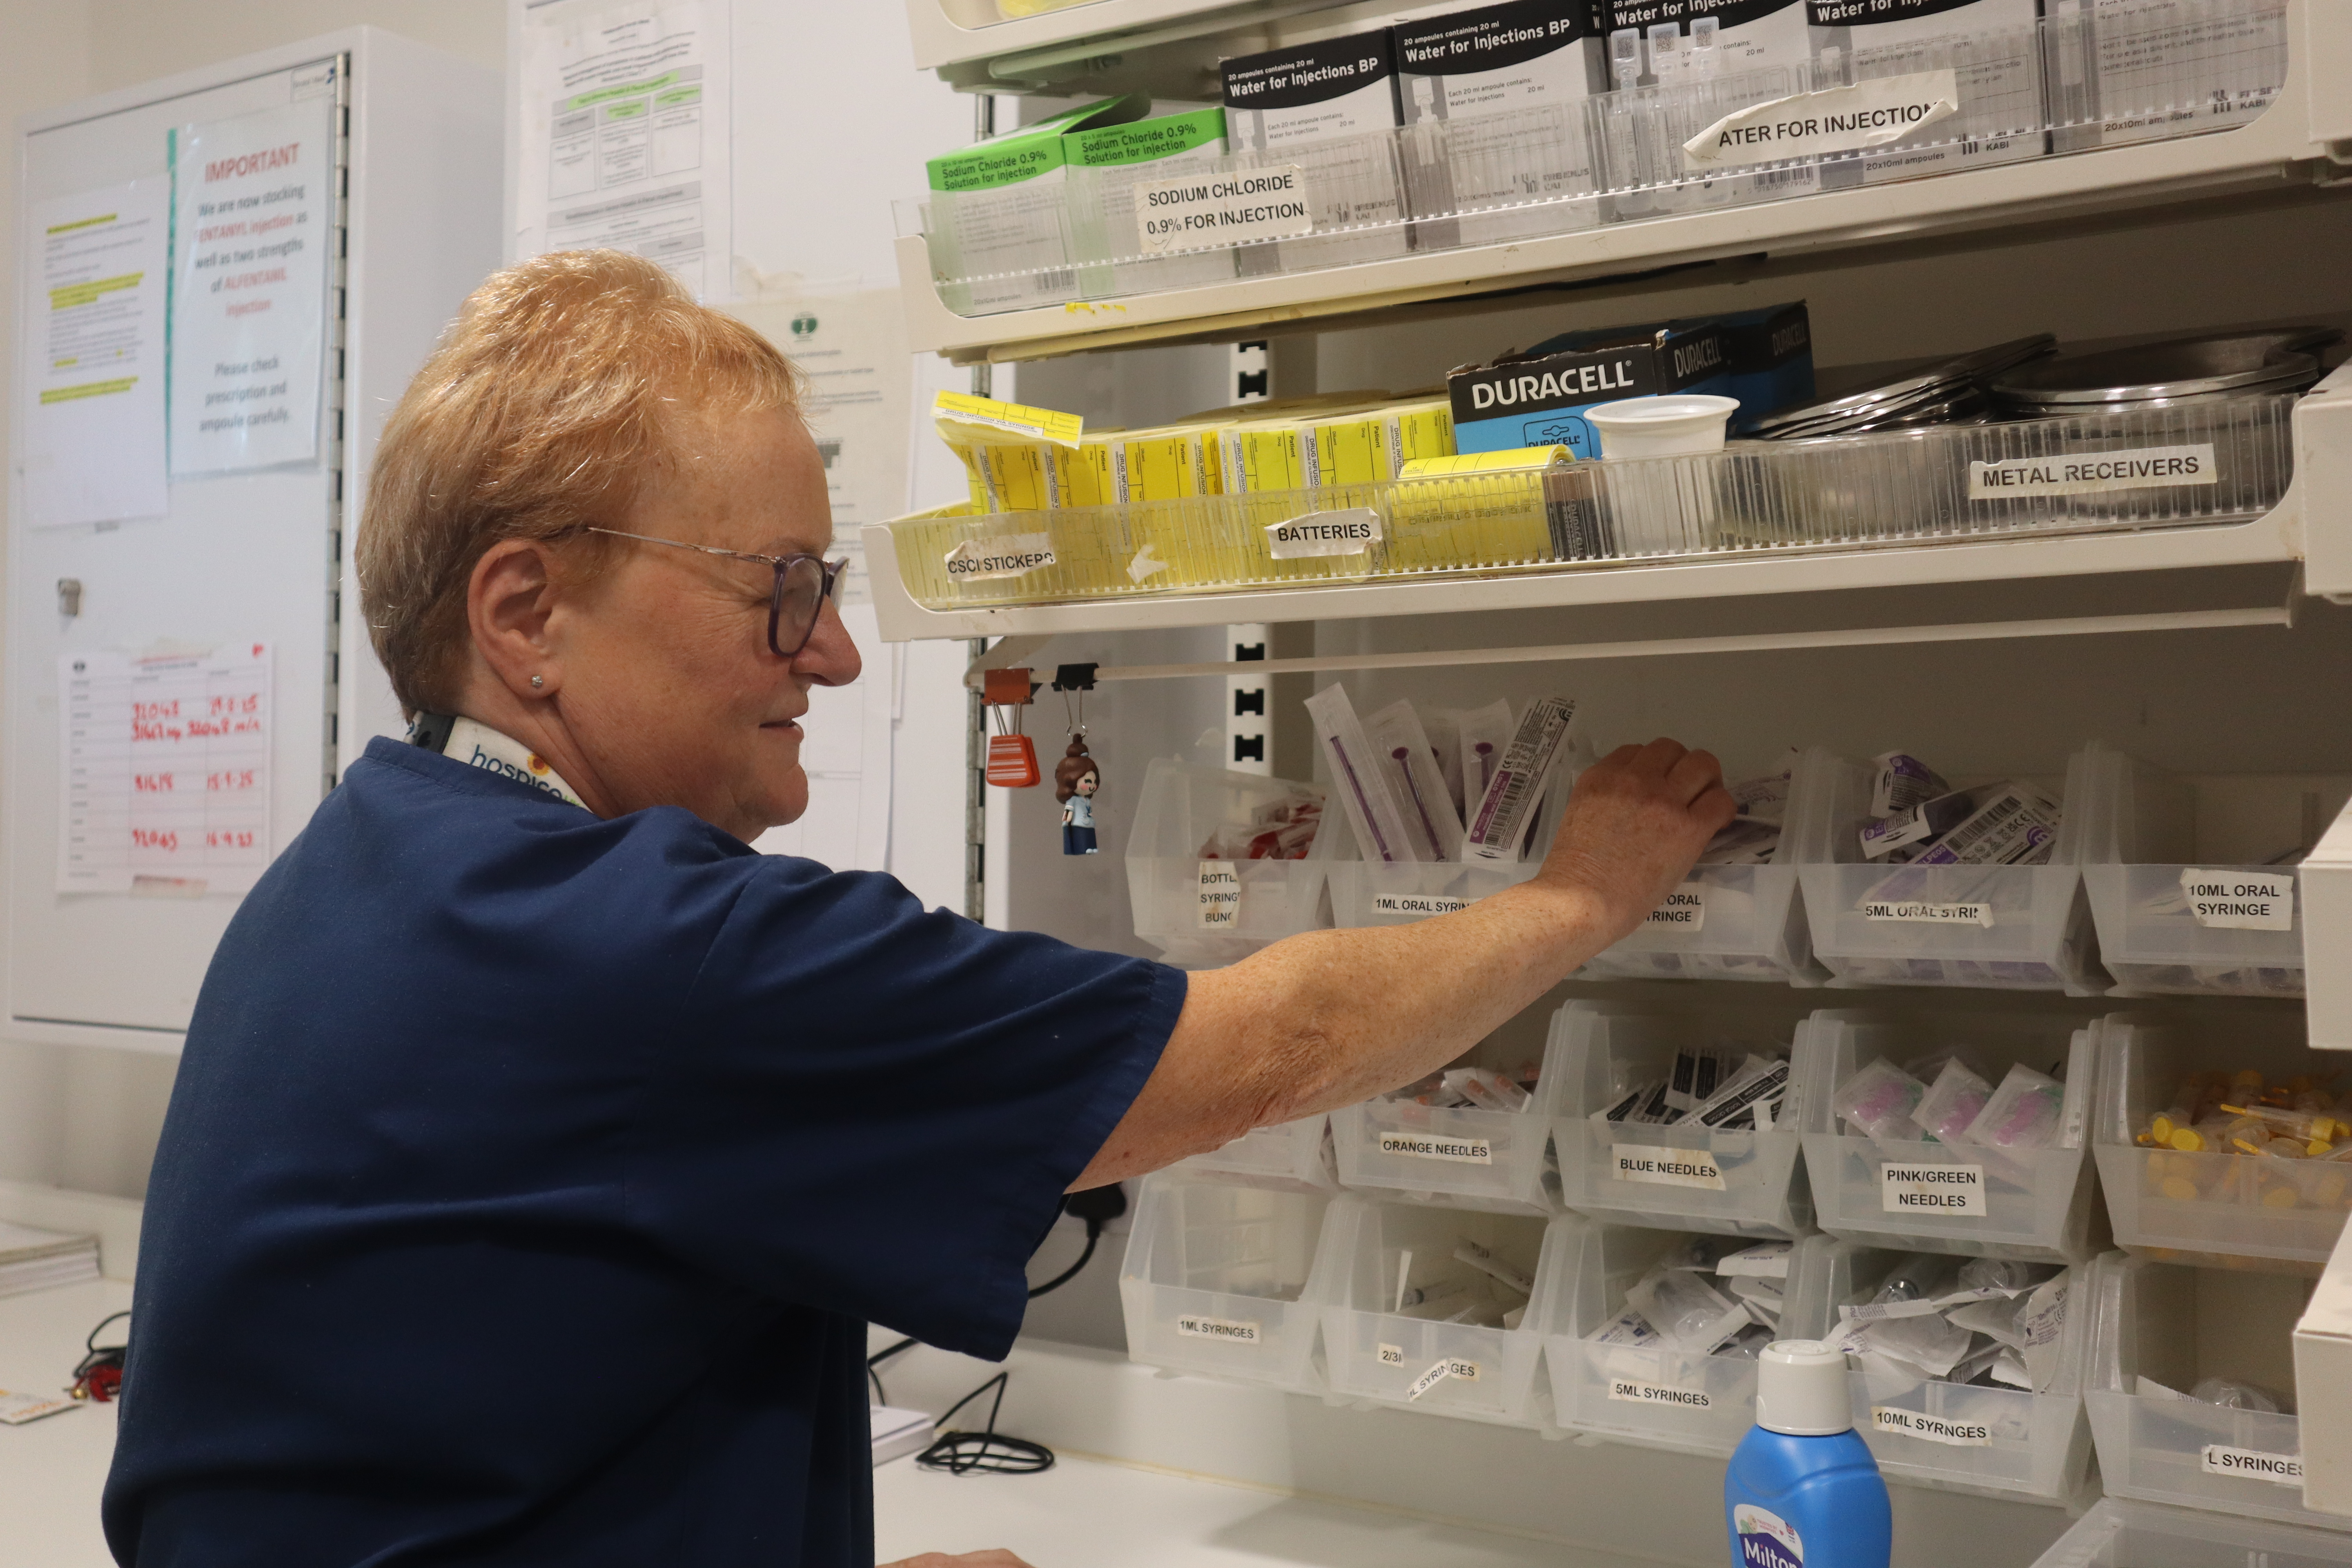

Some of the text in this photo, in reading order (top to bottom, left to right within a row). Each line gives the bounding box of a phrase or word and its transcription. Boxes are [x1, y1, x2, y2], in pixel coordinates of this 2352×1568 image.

[1615, 3, 1684, 26] Water for
[1817, 3, 1864, 22] Water
[1405, 19, 1570, 63] Water for Injections BP
[1414, 32, 1444, 45] ampoules
[1445, 25, 1478, 38] containing
[1479, 22, 1490, 31] 20
[1724, 40, 1751, 50] contains:
[1230, 57, 1378, 97] Water for Injections BP
[1238, 68, 1264, 80] ampoules
[1265, 62, 1295, 74] containing
[1481, 82, 1505, 94] ampoule
[1506, 77, 1532, 88] contains:
[1450, 98, 1467, 107] Water
[1477, 92, 1504, 102] Injections
[2239, 99, 2266, 109] KABI
[1297, 116, 1319, 127] ampoule
[1320, 112, 1344, 122] contains:
[2105, 119, 2146, 132] 20x10ml
[1082, 123, 1196, 152] Sodium Chloride 0.9%
[1294, 126, 1319, 136] Injections
[1719, 125, 1771, 147] ATER
[1777, 118, 1818, 139] FOR
[1084, 140, 1186, 165] Solution for injection
[1986, 141, 2009, 151] KABI
[205, 142, 300, 182] IMPORTANT
[942, 150, 1047, 179] Sodium Chloride 0.9%
[1866, 152, 1945, 171] 20x10ml ampoules
[944, 165, 1037, 190] Solution for injection
[198, 183, 305, 216] We are now stocking
[1149, 185, 1208, 207] SODIUM
[1212, 174, 1294, 198] CHLORIDE
[1147, 202, 1305, 235] 0.9% FOR INJECTION
[196, 252, 216, 269] well
[997, 293, 1022, 303] ampoules
[1771, 322, 1806, 356] DURACELL
[1674, 335, 1722, 379] DURACELL
[269, 378, 287, 396] and
[1472, 361, 1634, 409] DURACELL
[965, 413, 995, 423] INFUSION
[1007, 422, 1035, 430] SYRINGE
[1984, 456, 2200, 487] METAL RECEIVERS
[1278, 523, 1371, 541] BATTERIES
[947, 559, 980, 573] CSCI
[1201, 873, 1236, 884] BOTTL
[1667, 895, 1701, 905] ORAL
[2189, 885, 2280, 897] 10ML ORAL
[1376, 899, 1470, 912] 1ML ORAL SYRIN
[1866, 906, 1893, 917] 5ML
[1898, 906, 1937, 917] ORAL
[2197, 903, 2270, 916] SYRINGE
[1647, 911, 1691, 922] RINGE
[1383, 1141, 1487, 1157] ORANGE NEEDLES
[1621, 1159, 1717, 1177] BLUE NEEDLES
[1887, 1170, 1976, 1184] PINK/GREEN
[1899, 1194, 1966, 1207] NEEDLES
[1180, 1321, 1254, 1339] 1ML SYRINGES
[1616, 1384, 1710, 1406] 5ML SYRINGES
[1877, 1411, 1987, 1438] 10ML SYRNGES
